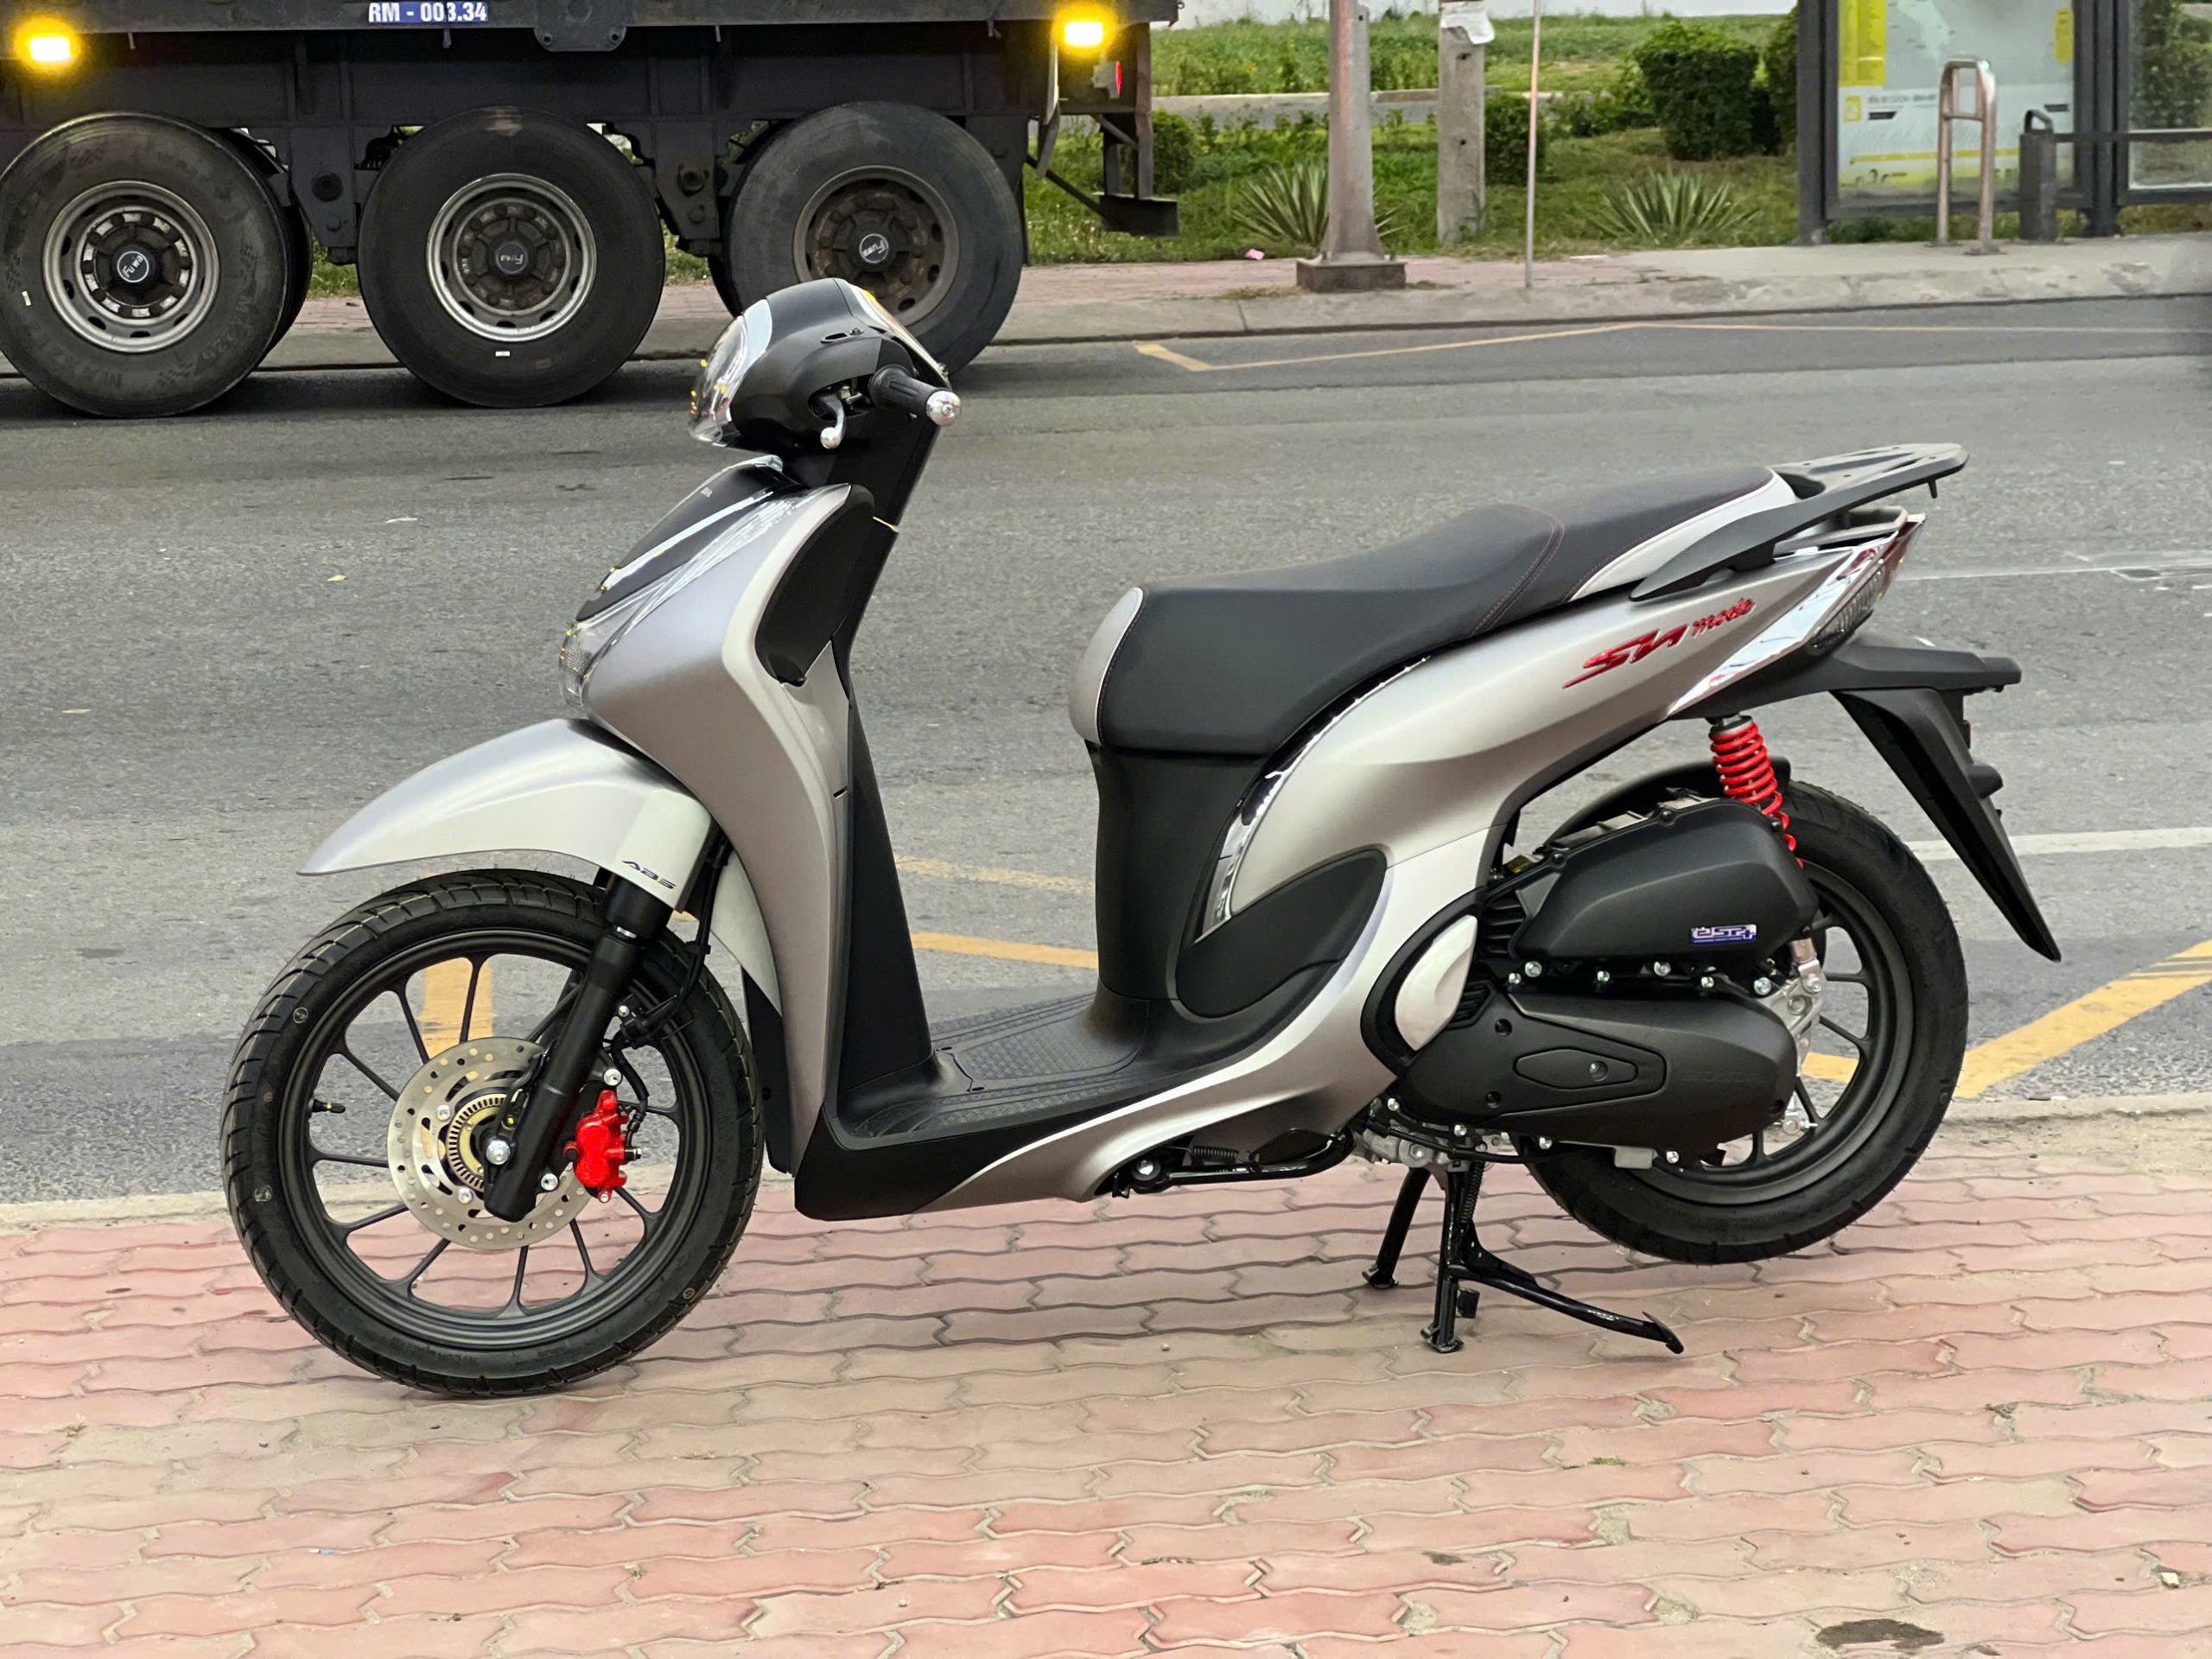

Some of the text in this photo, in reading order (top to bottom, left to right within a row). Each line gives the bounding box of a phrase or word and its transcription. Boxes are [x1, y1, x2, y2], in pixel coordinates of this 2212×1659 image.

[368, 3, 400, 22] RM
[420, 3, 487, 22] 003.34
[621, 860, 677, 890] ABS
